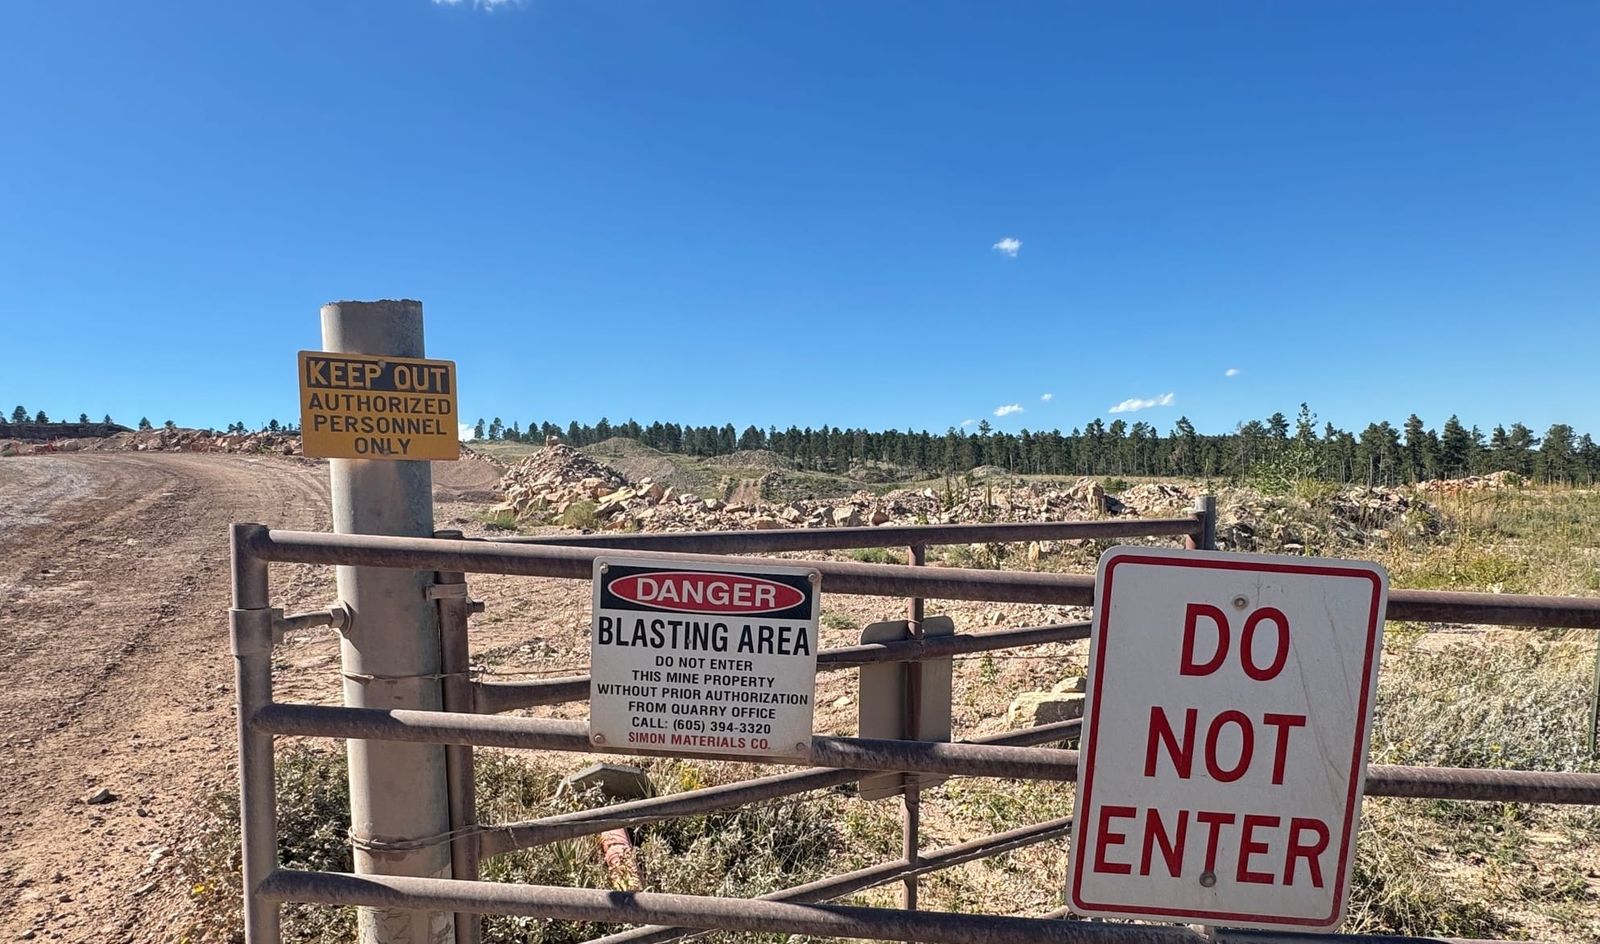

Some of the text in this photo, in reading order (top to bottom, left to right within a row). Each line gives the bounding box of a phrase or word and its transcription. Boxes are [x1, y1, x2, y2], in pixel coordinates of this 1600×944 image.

[309, 360, 446, 392] KEEP OUT
[309, 393, 450, 414] AUTHORIZED
[314, 415, 447, 435] PERSONNEL
[355, 438, 411, 455] ONLY
[636, 577, 776, 607] DANGER
[599, 616, 809, 656] BLASTING AREA
[1180, 603, 1290, 681] DO
[656, 656, 753, 671] DO NOT ENTER
[632, 670, 775, 688] THIS MINE PROPERTY
[598, 684, 808, 704] WITHOUT PRIOR AUTHORIZATION
[628, 701, 776, 719] FROM QUARRY OFFICE
[632, 717, 770, 734] CALL: (605) 394-3320
[628, 732, 770, 750] SIMON MATERIALS CO.
[1144, 706, 1306, 785] NOT
[1094, 806, 1329, 888] ENTER
